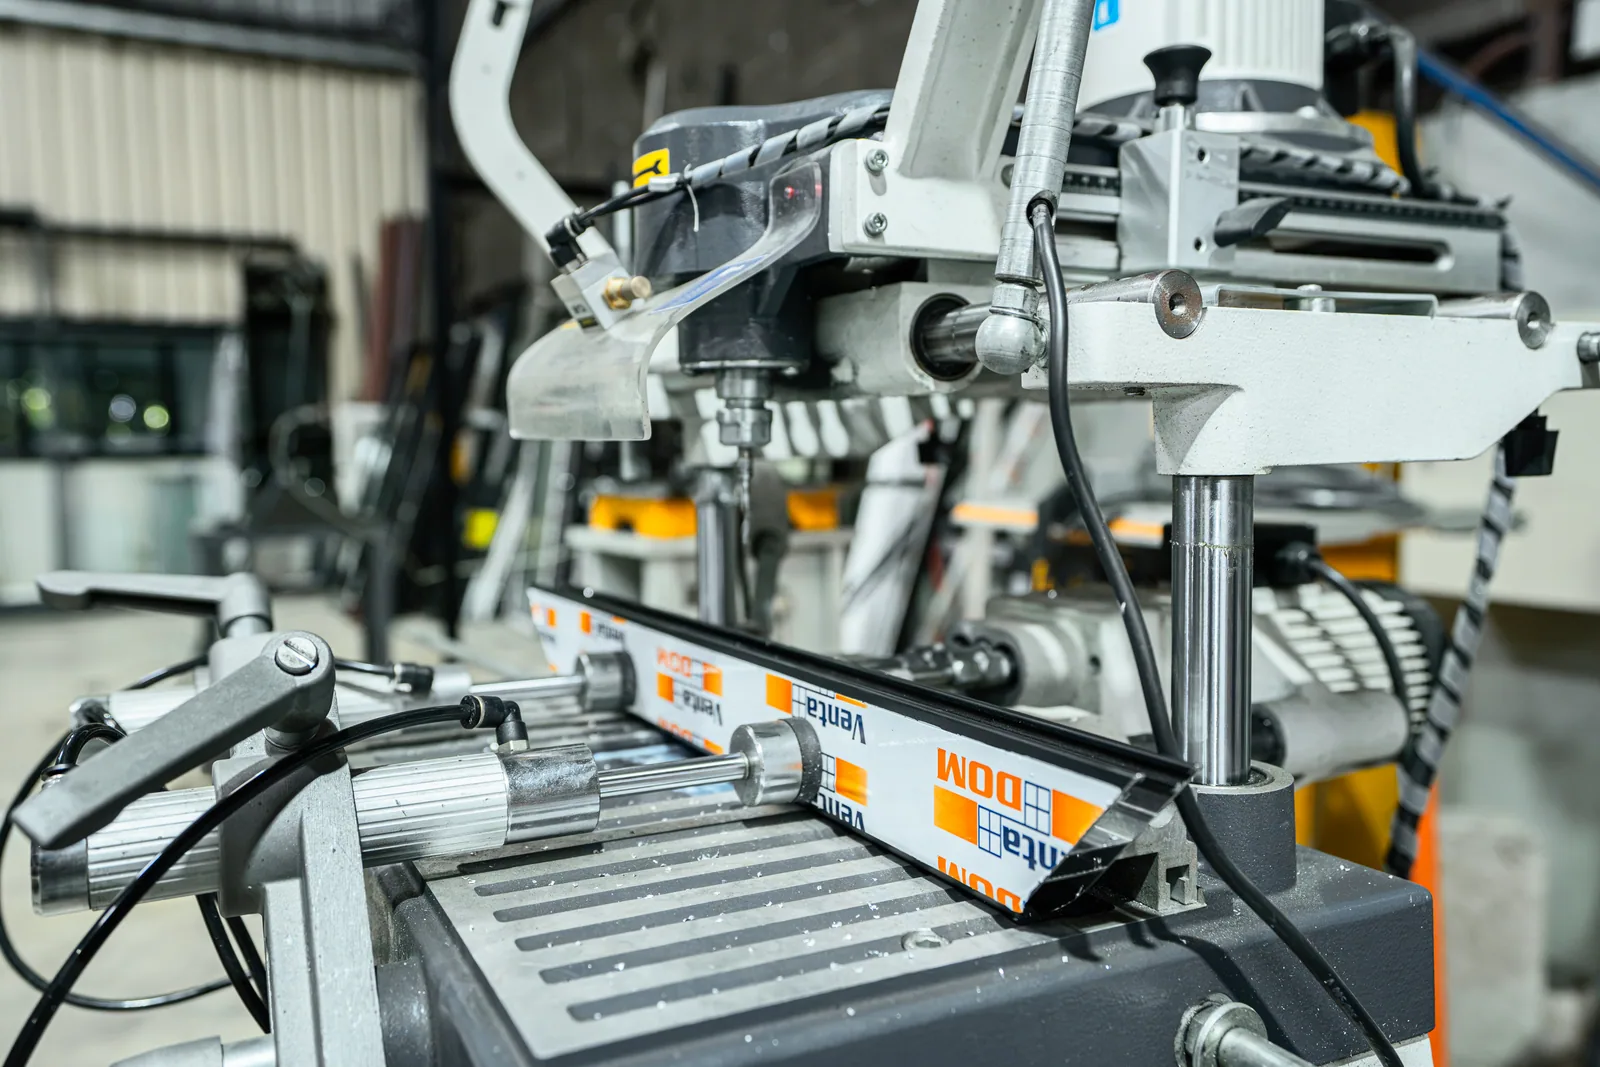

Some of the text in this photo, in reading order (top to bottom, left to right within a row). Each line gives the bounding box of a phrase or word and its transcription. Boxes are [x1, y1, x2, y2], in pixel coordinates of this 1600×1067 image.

[807, 696, 867, 745] Venta
[937, 747, 1022, 812] DOM
[1003, 825, 1067, 871] nta
